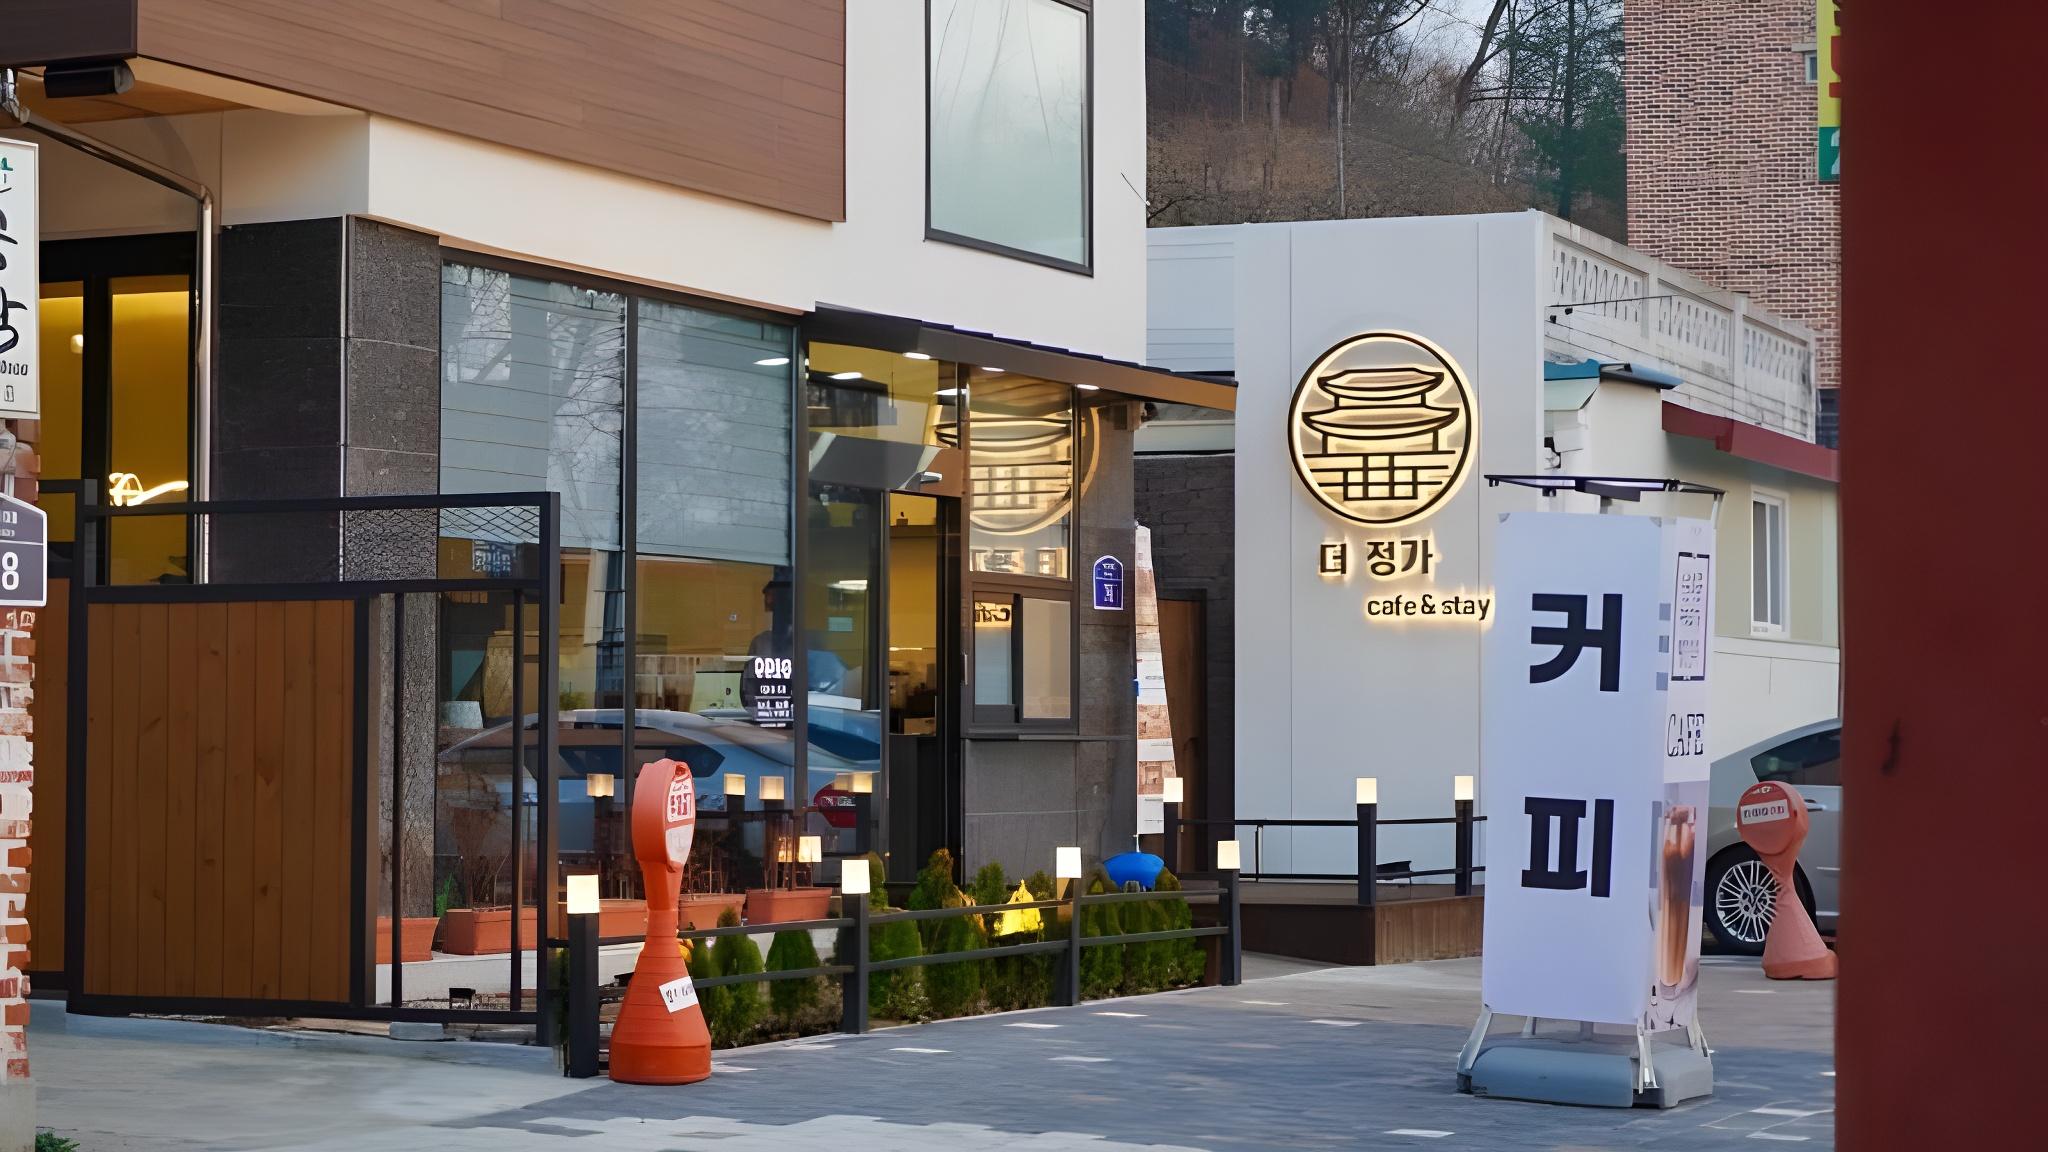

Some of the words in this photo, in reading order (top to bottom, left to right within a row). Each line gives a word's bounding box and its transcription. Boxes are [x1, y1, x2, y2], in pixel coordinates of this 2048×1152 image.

[1367, 539, 1433, 576] 정가
[1367, 595, 1417, 616] cafe
[1421, 594, 1436, 615] &
[1441, 596, 1490, 621] stay
[1521, 593, 1623, 898] 커피
